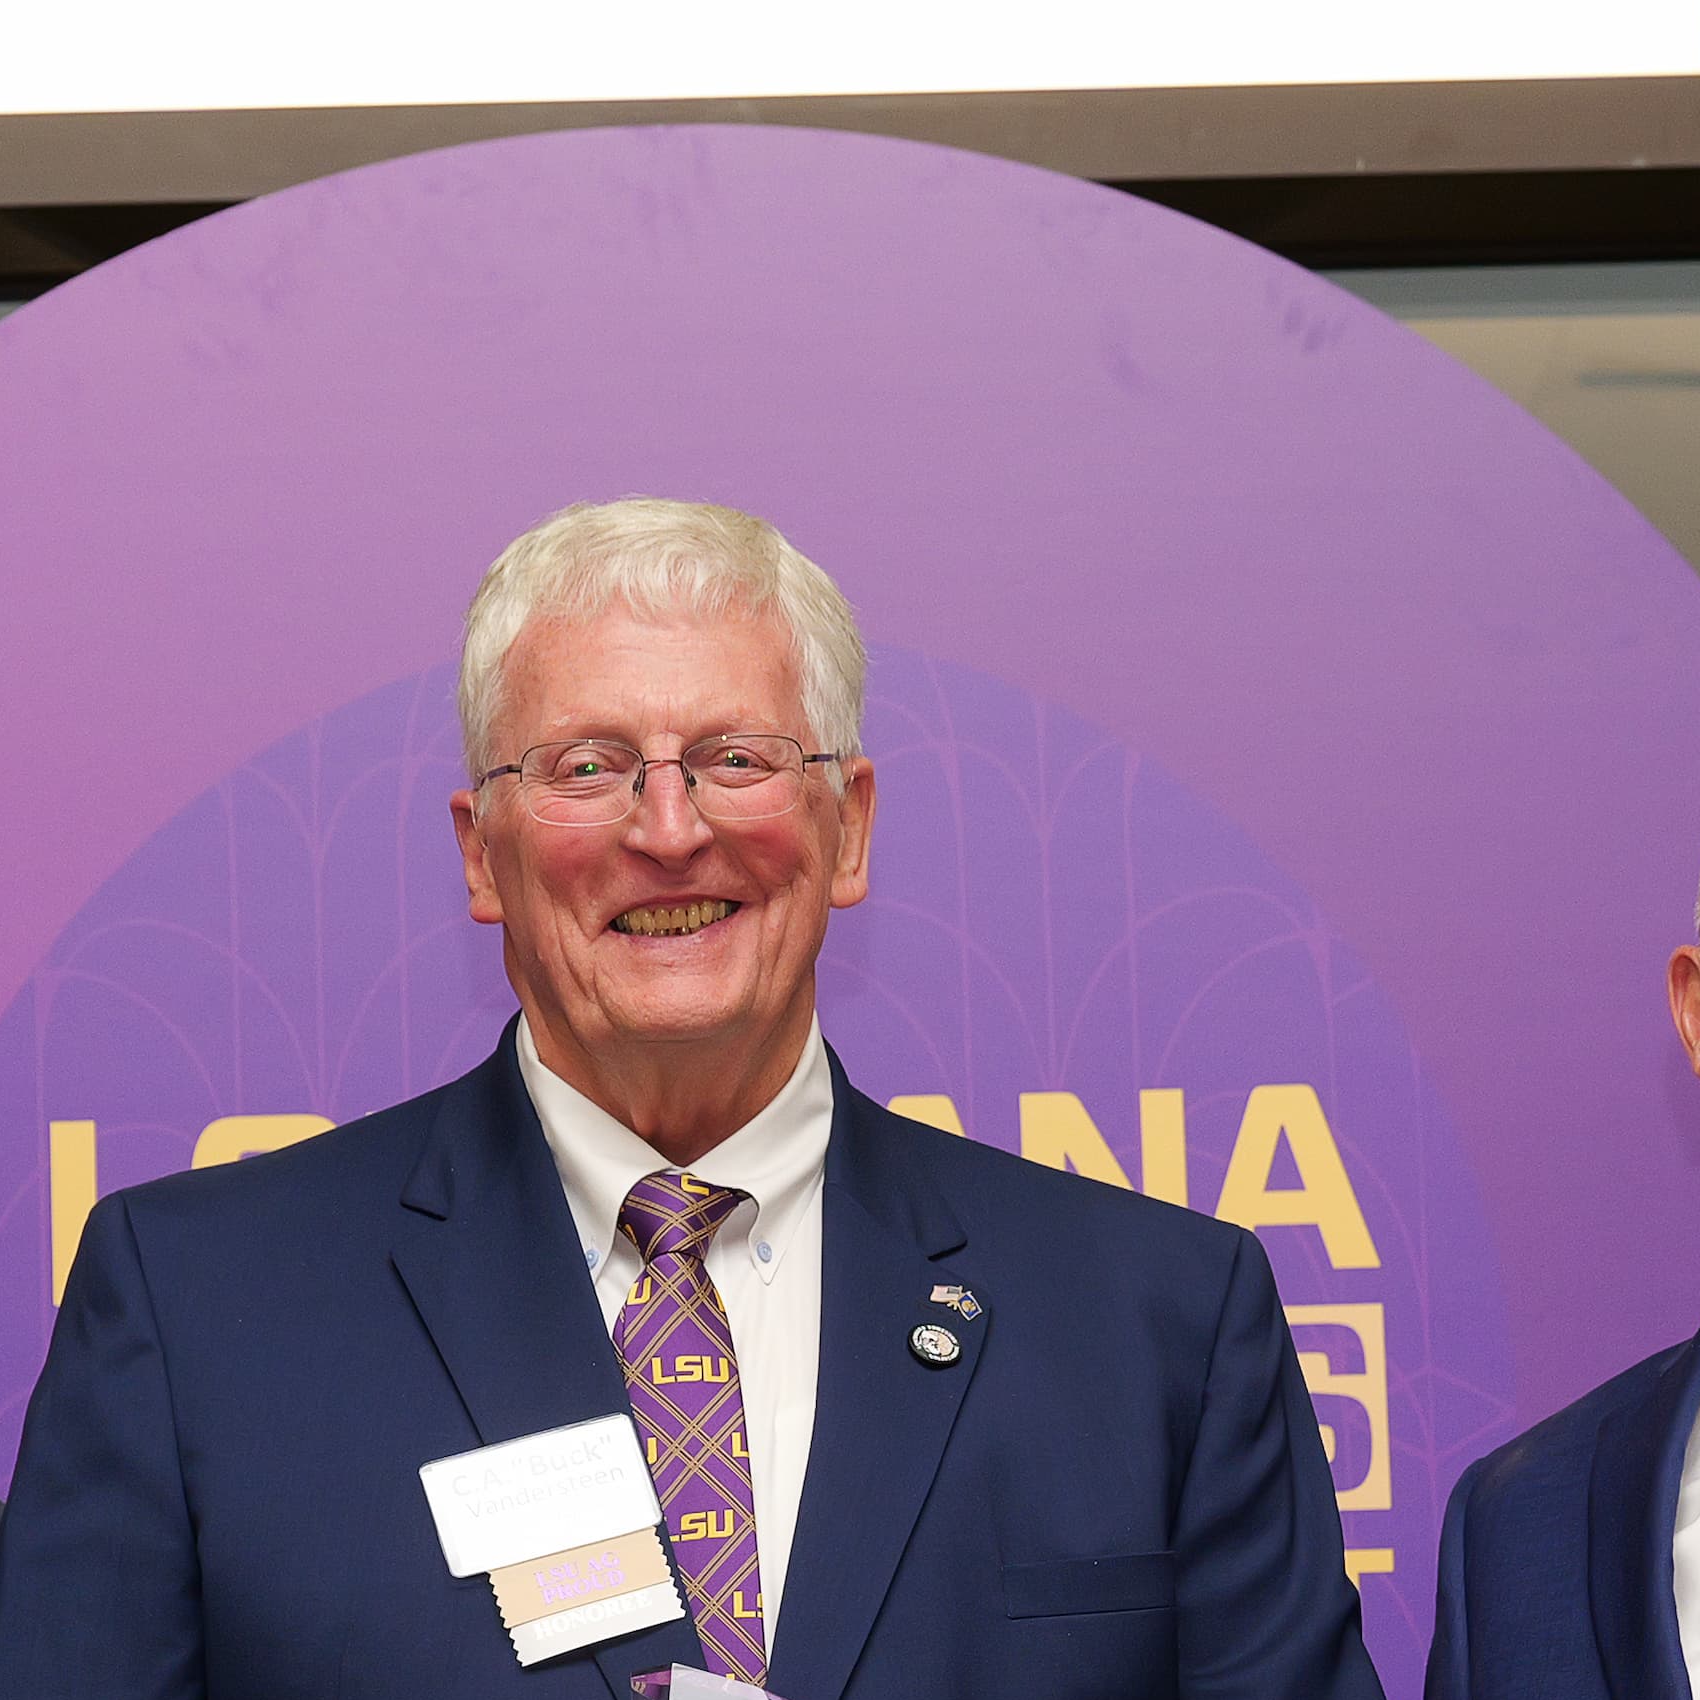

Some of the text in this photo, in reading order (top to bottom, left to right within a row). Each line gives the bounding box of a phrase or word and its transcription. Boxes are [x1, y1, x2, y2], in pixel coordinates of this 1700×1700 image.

[652, 1355, 730, 1385] LSU
[669, 1509, 735, 1543] SU
[533, 1561, 580, 1588] LSU
[541, 1569, 627, 1606] PROUD
